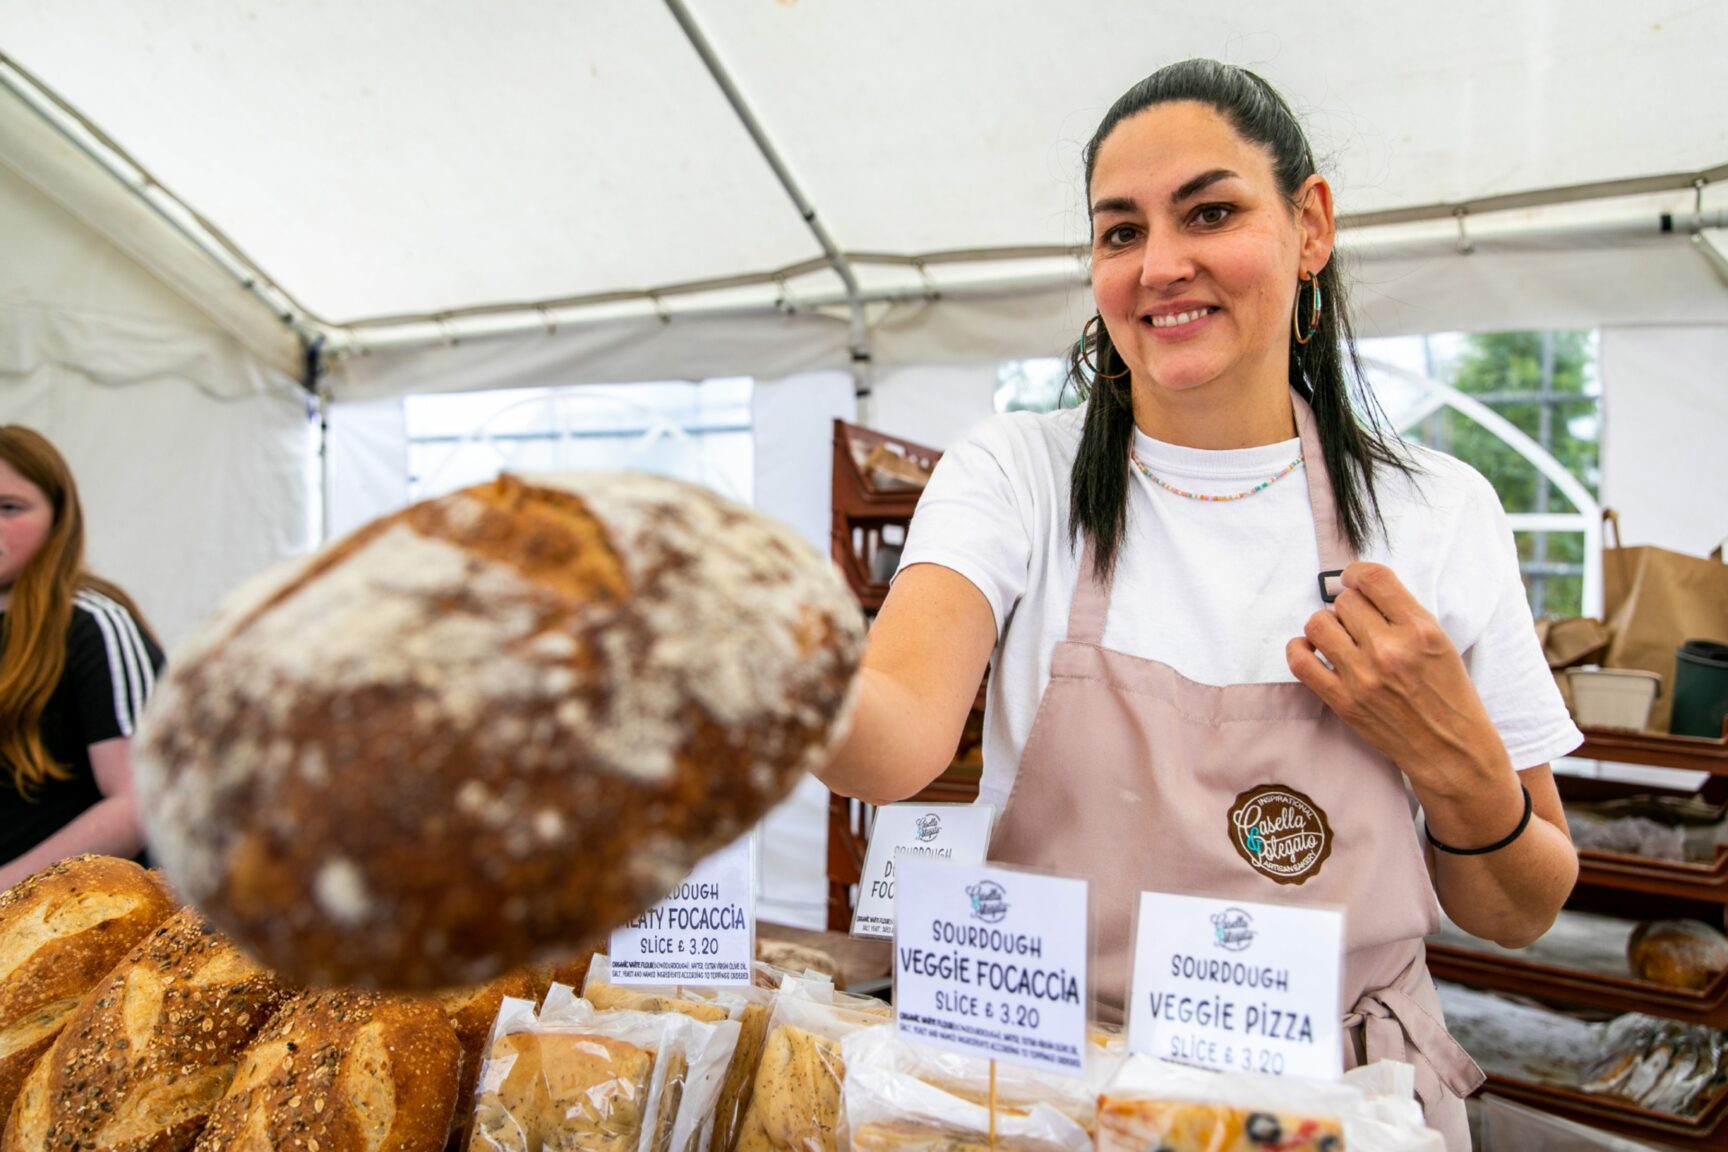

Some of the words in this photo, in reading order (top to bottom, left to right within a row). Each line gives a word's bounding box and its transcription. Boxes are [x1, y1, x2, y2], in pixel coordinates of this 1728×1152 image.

[1233, 805, 1306, 837] Casella
[1257, 795, 1314, 820] INSPIRATIONAL
[1263, 860, 1294, 873] ARTISAN
[689, 937, 719, 955] 3.20
[932, 920, 1042, 958] SOURDOUGH
[1171, 954, 1289, 992] SOURDOUGH
[1000, 1003, 1040, 1029] 3.20
[1242, 1048, 1284, 1076] 3.20
